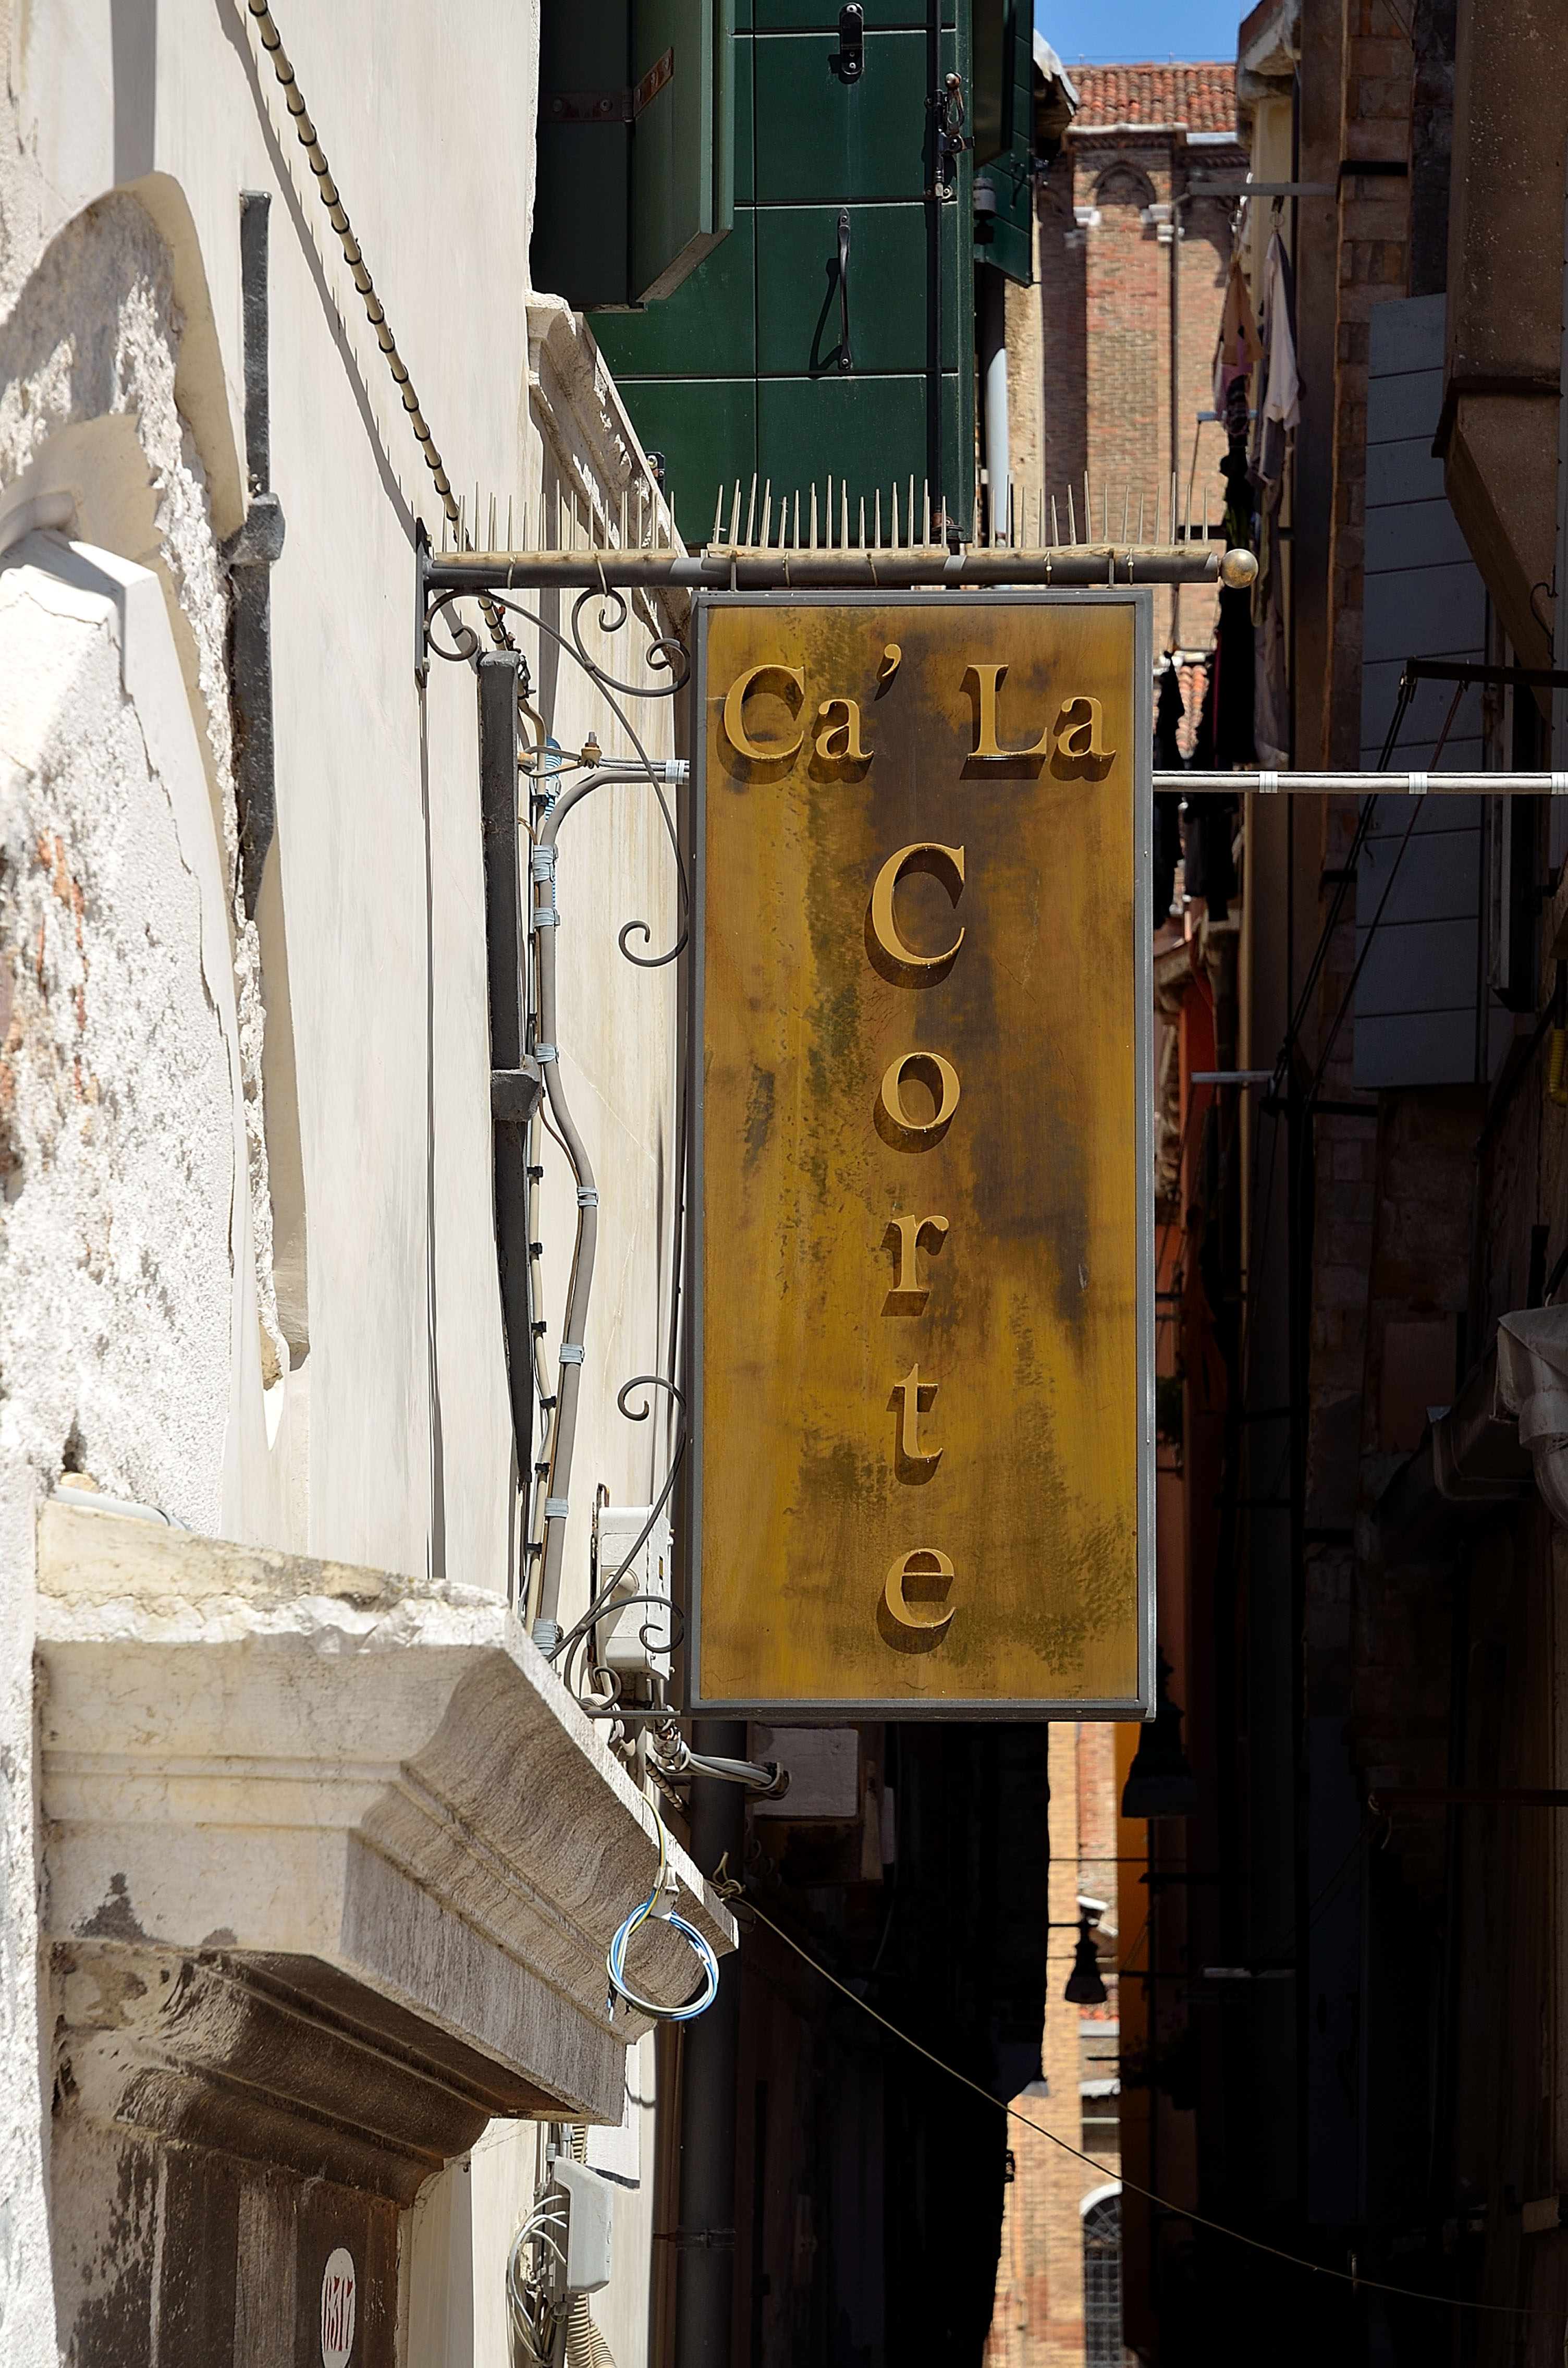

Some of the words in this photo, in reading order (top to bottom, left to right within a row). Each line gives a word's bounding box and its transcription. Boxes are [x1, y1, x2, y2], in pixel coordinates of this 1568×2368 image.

[723, 643, 902, 761] Ca'
[966, 664, 1117, 759] La
[872, 842, 965, 1628] Corte
